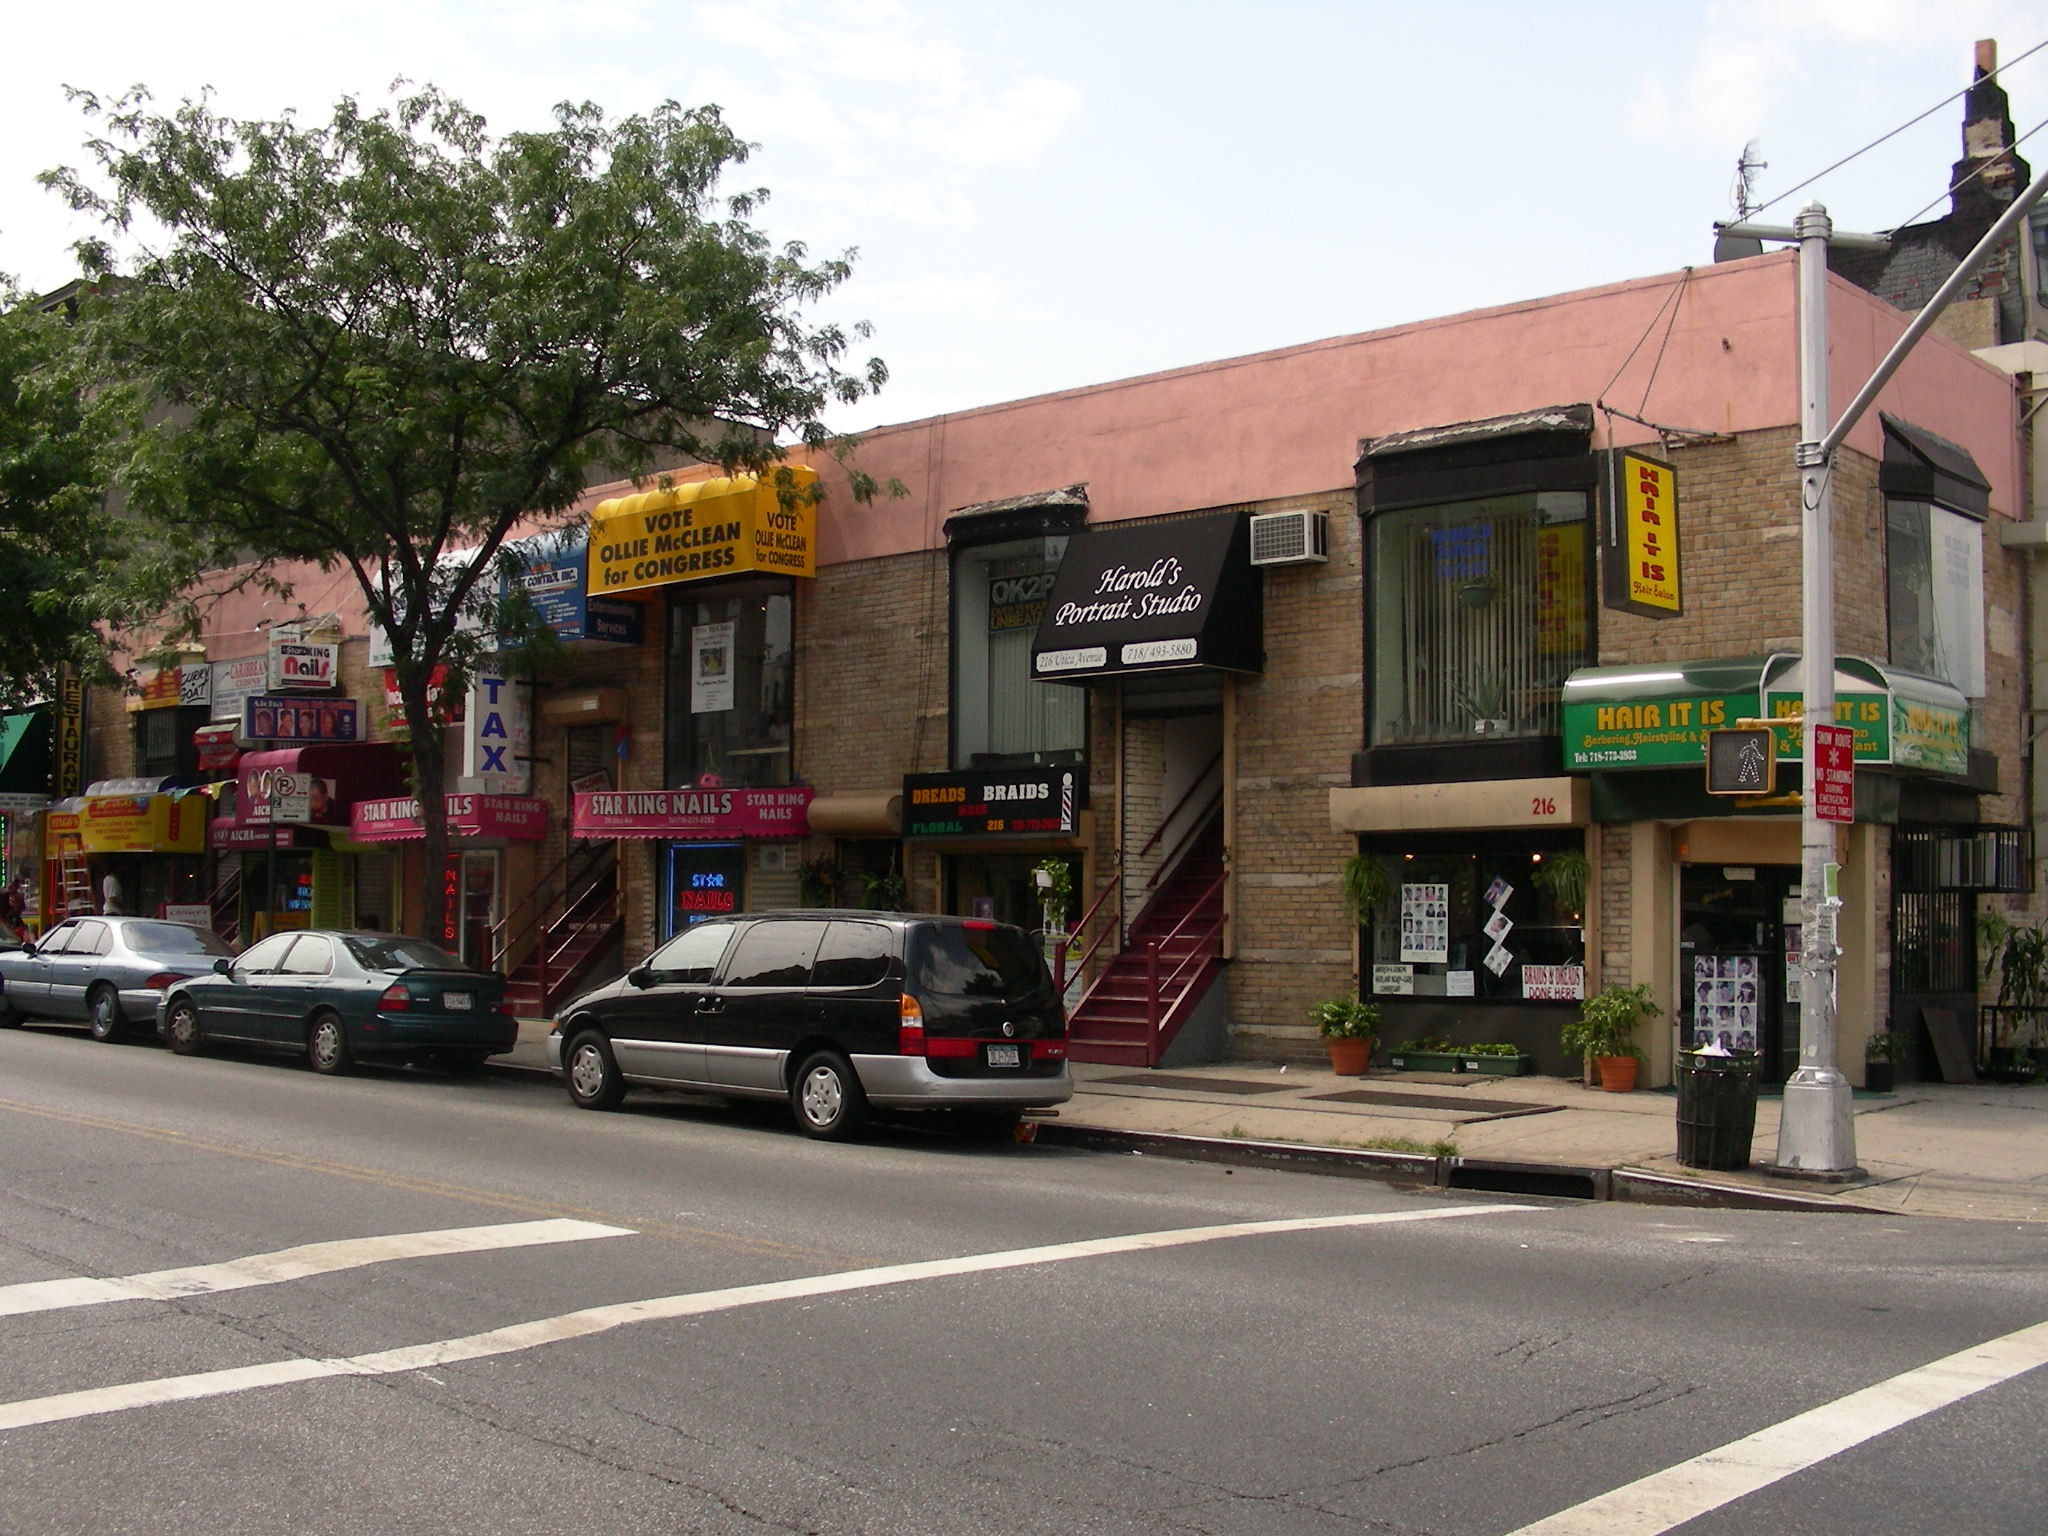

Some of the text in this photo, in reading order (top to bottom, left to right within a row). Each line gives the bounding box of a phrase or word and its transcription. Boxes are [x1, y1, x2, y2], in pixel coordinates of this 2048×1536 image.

[645, 509, 693, 533] VOTE
[767, 511, 797, 531] VOTE
[600, 521, 741, 563] OLLIE McCLEAN
[755, 529, 807, 552] OLLIE McCLEAN
[604, 547, 735, 586] for CONGRESS
[756, 550, 805, 569] for CONGRESS
[1095, 557, 1183, 595] Harold's
[1642, 561, 1665, 581] IS
[1633, 581, 1675, 600] Hair Salon
[1055, 585, 1202, 626] Portrait Studio
[306, 648, 330, 658] KING
[1039, 651, 1103, 668] 216 Utica Avenue
[181, 667, 210, 687] CURRY
[230, 659, 268, 680] CARIBBEAN
[180, 680, 208, 701] GOAT
[1597, 700, 1725, 731] HAIR IT IS
[1861, 703, 1881, 721] IS
[481, 678, 507, 772] TAX
[1689, 731, 1696, 741] &
[1817, 731, 1851, 749] SNOW ROUTE
[1574, 752, 1588, 763] Tel:
[1826, 768, 1851, 785] STANDING
[746, 794, 804, 806] STAR KING
[912, 783, 1049, 804] DREADS BRAIDS
[1819, 793, 1848, 806] EMERGENCY
[363, 801, 387, 822] STAR
[389, 799, 420, 819] KING
[484, 799, 540, 813] STAR KING
[592, 793, 732, 815] STAR KING NAILS
[1532, 797, 1556, 815] 216
[496, 812, 528, 824] NAILS
[759, 808, 792, 820] NAILS
[230, 829, 254, 841] AICHA
[912, 821, 963, 834] FLORAL
[987, 819, 1004, 831] 216
[445, 870, 456, 938] NAILS
[1524, 966, 1580, 986] BRAIDS & DREADS
[1529, 987, 1576, 1000] DONE HERE
